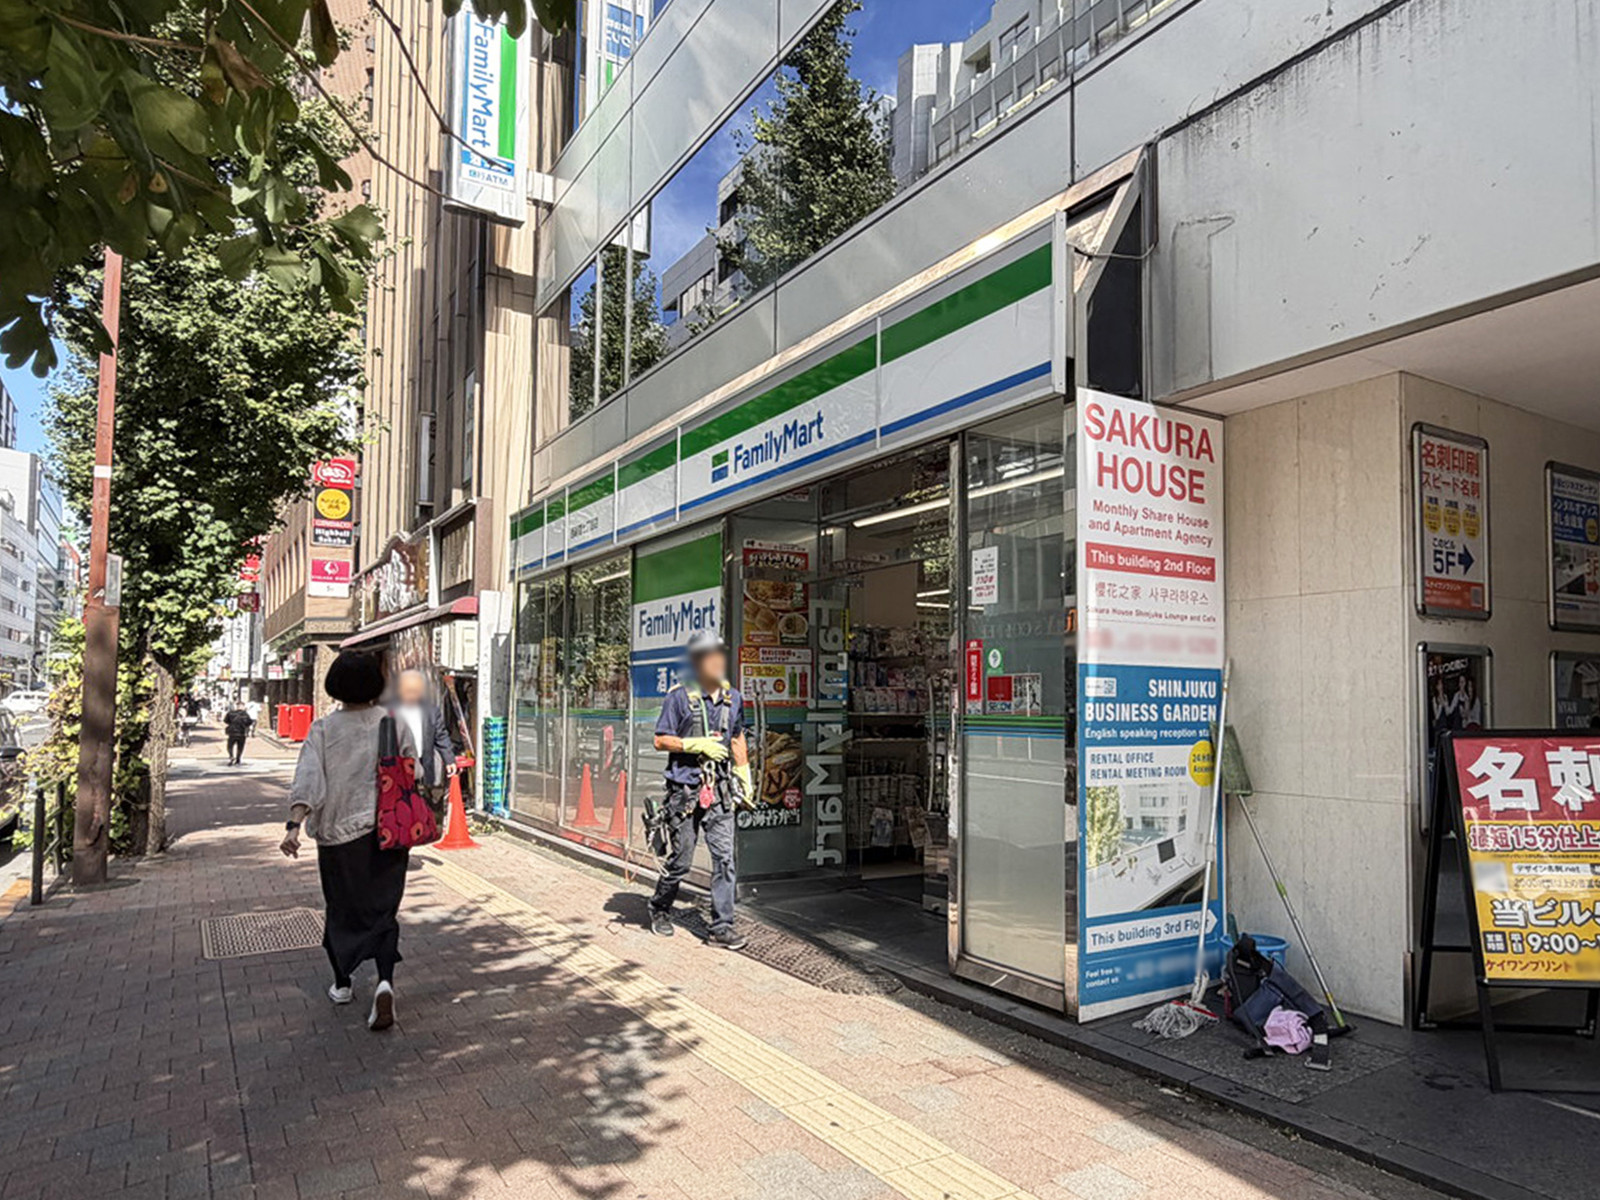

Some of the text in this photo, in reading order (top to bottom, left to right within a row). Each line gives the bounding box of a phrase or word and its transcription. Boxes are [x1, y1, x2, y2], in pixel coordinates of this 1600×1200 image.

[470, 22, 494, 148] FamilyMart
[734, 410, 824, 474] FamilyMart
[1085, 403, 1215, 463] SAKURA
[1422, 441, 1479, 477] 名刺印刷
[1097, 451, 1205, 504] HOUSE
[1093, 499, 1209, 528] Monthly Share House
[1088, 519, 1213, 548] and Apartment Agency
[1091, 549, 1212, 575] This building 2nd Floor
[1433, 549, 1456, 575] 5F
[1085, 605, 1110, 614] Skura
[1148, 587, 1209, 605] 사쿠라하우스
[639, 597, 715, 641] FamilyMart
[1148, 679, 1217, 698] SHINJUKU
[1085, 702, 1217, 722] BUSINESS GARDEN
[1085, 727, 1118, 740] English
[1120, 728, 1158, 740] speaking
[1159, 728, 1197, 739] reception
[1091, 752, 1154, 764] RENTAL OFFICE
[1091, 766, 1187, 780] RENTAL MEETING ROOM
[1466, 746, 1600, 811] 名刺
[1470, 824, 1600, 851] 最短15分仕上
[1091, 917, 1210, 945] This building 3rd Flor
[1486, 960, 1572, 972] ケイワンプリント
